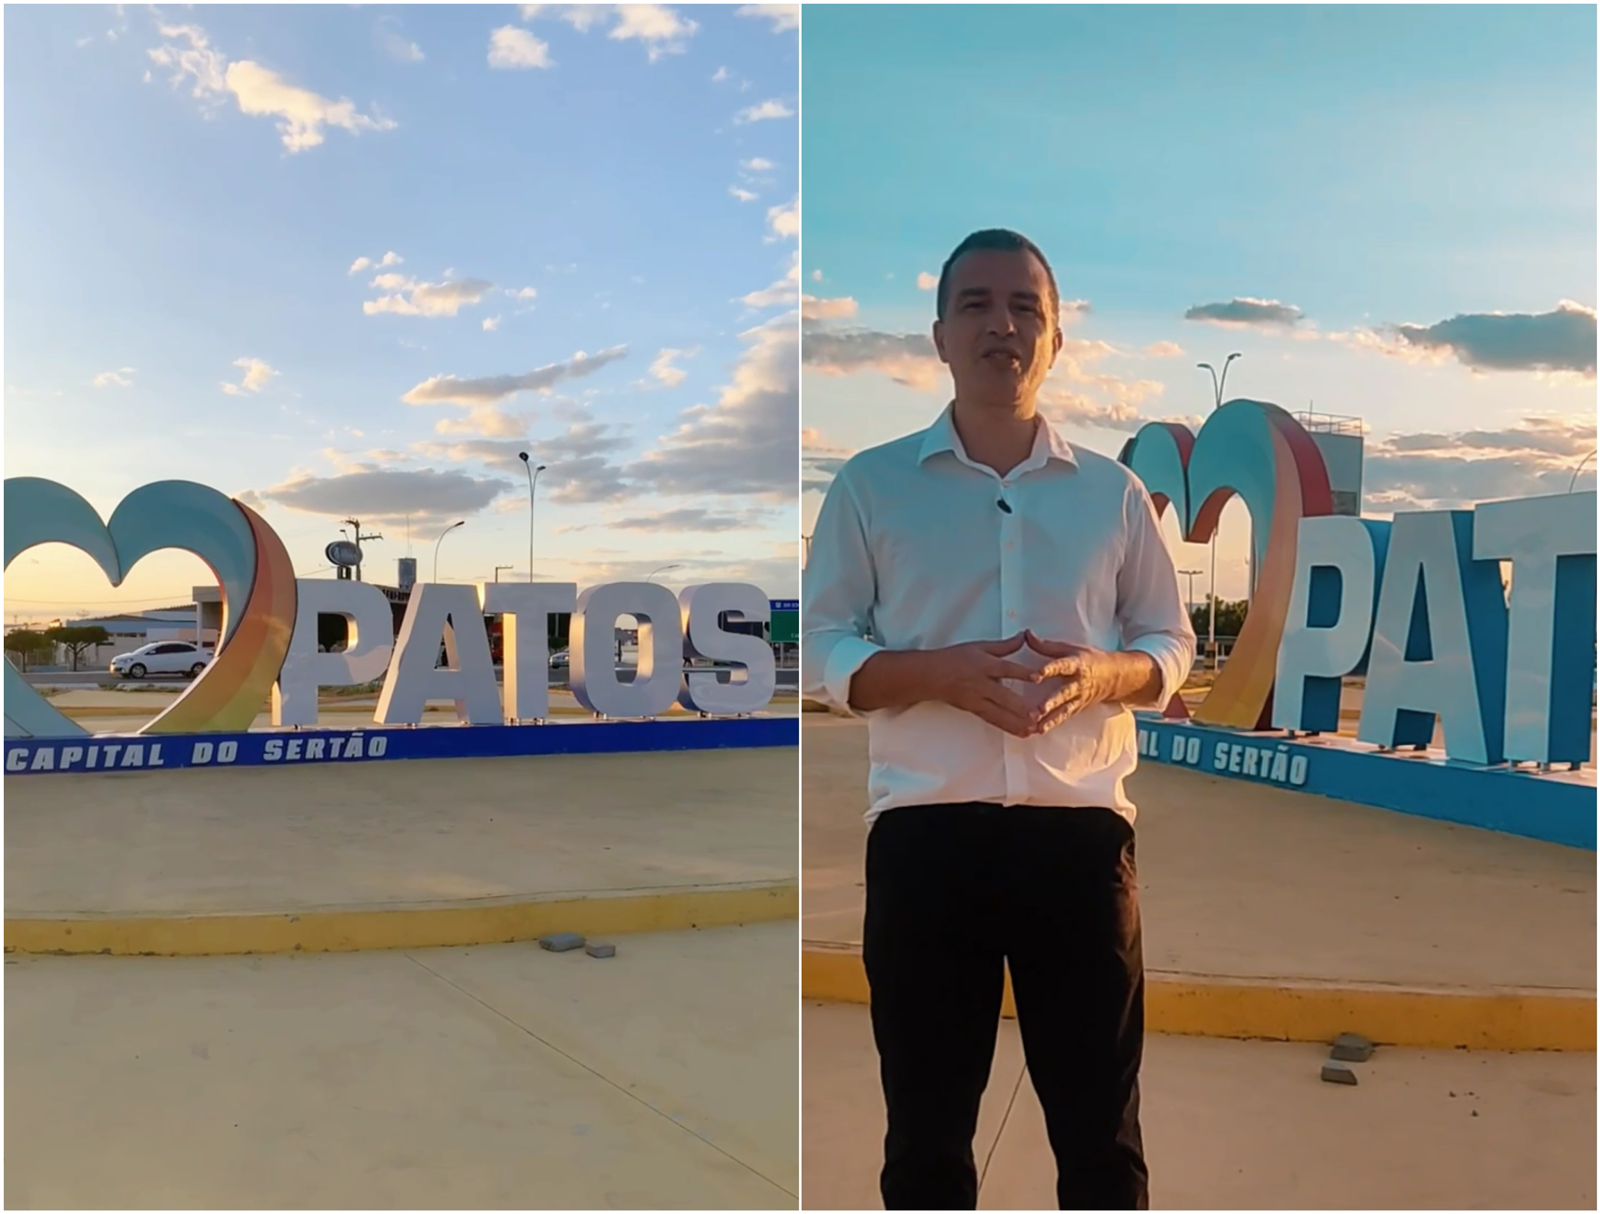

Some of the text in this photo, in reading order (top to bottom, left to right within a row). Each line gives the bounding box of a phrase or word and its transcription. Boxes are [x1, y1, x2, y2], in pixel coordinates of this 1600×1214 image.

[273, 577, 776, 727] PATOS
[1272, 489, 1598, 766] PAT
[6, 732, 388, 771] CAPITAL DO SERTÃO
[1171, 734, 1201, 765] DO
[1213, 741, 1309, 785] SERTÃO
